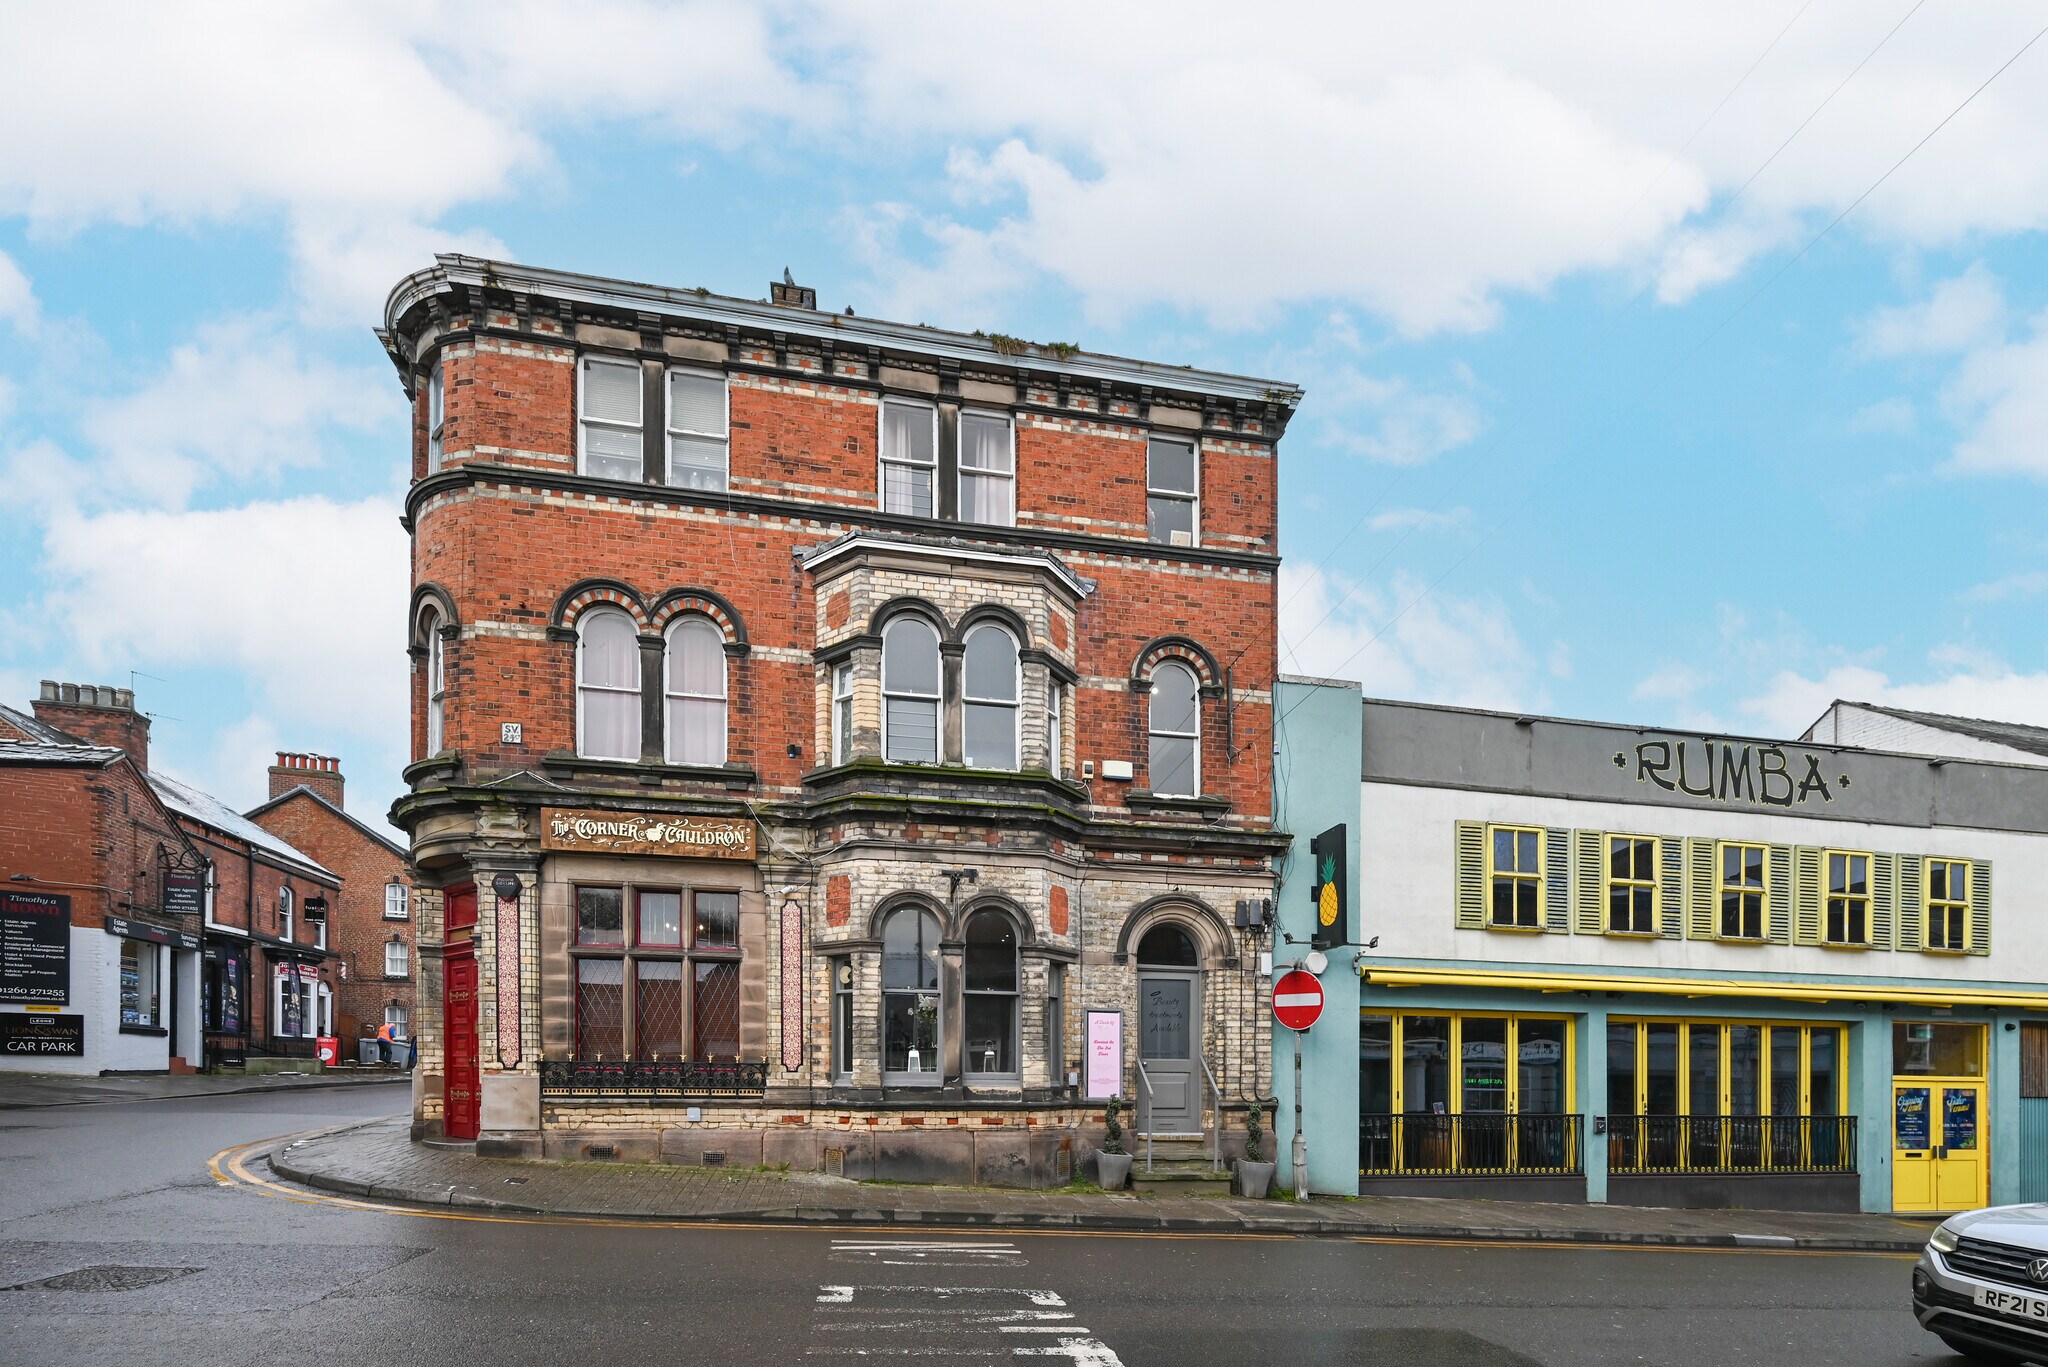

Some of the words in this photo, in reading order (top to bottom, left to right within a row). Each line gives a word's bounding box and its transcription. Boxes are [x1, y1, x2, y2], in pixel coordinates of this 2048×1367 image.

[1635, 739, 1833, 808] RUMBA
[551, 820, 569, 836] The
[575, 818, 638, 839] CORNER
[664, 825, 745, 846] CAULDRON
[2, 897, 60, 916] brown
[10, 895, 48, 905] Timothy
[114, 919, 127, 927] Estate
[113, 926, 128, 934] Agents
[30, 988, 64, 997] 271255
[1152, 996, 1179, 1009] Beauty
[7, 1042, 36, 1051] CAR
[41, 1042, 76, 1052] PARK
[1897, 1096, 1924, 1110] Opening
[1986, 1290, 2027, 1313] RF21
[2033, 1301, 2048, 1318] S
